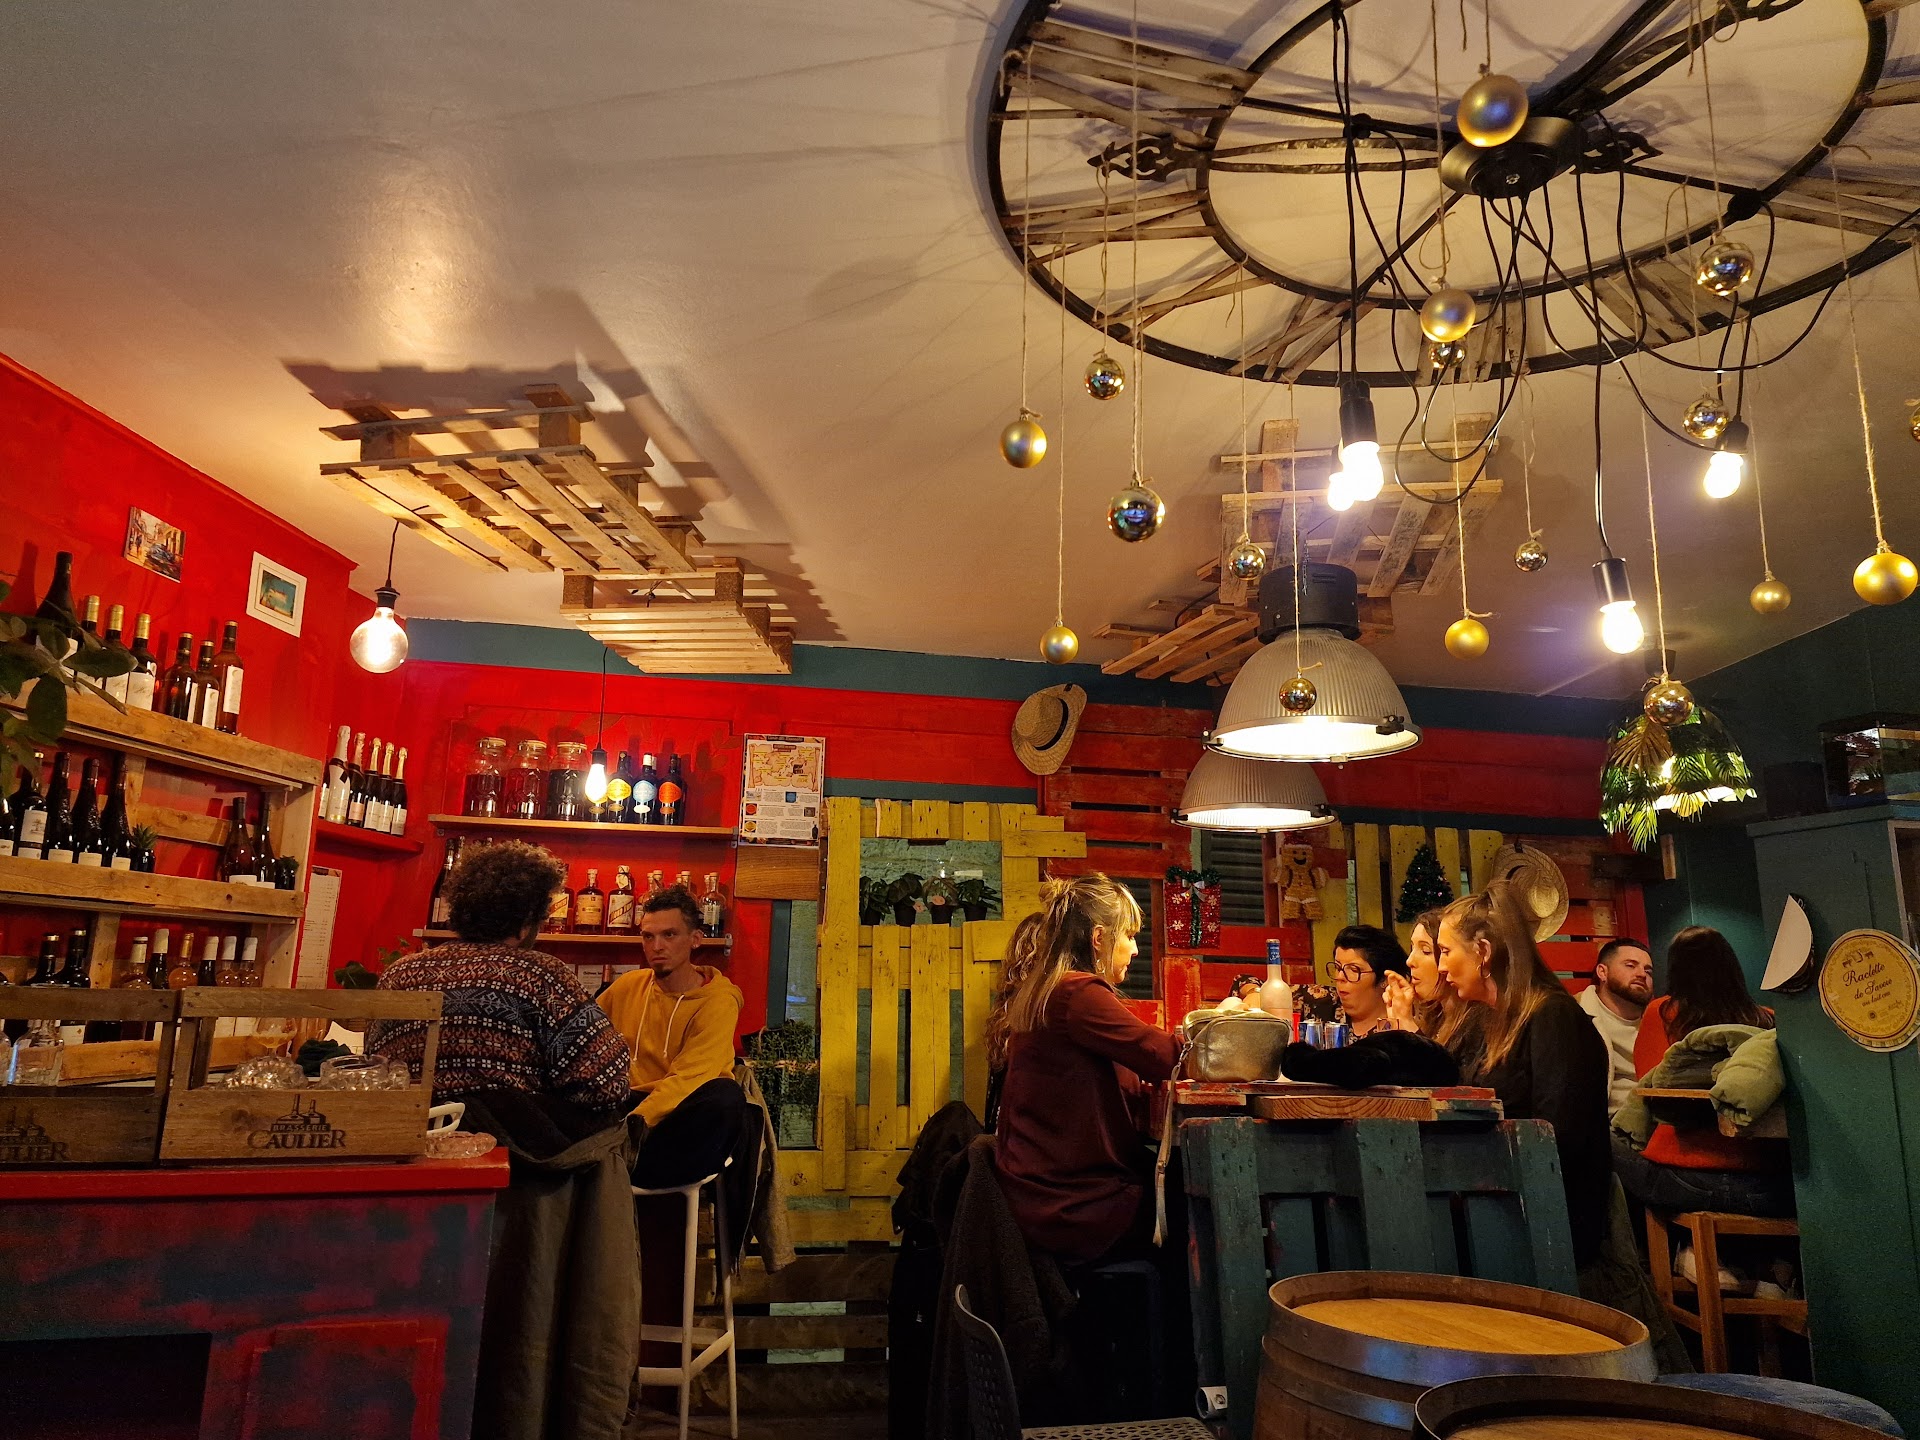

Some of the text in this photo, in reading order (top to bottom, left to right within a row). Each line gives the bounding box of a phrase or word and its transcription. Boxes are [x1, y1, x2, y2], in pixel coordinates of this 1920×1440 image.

[1842, 962, 1886, 987] Raclette
[1854, 979, 1893, 1000] de Savoie
[272, 1124, 328, 1132] BRASSERIE
[246, 1129, 347, 1150] CAULIER
